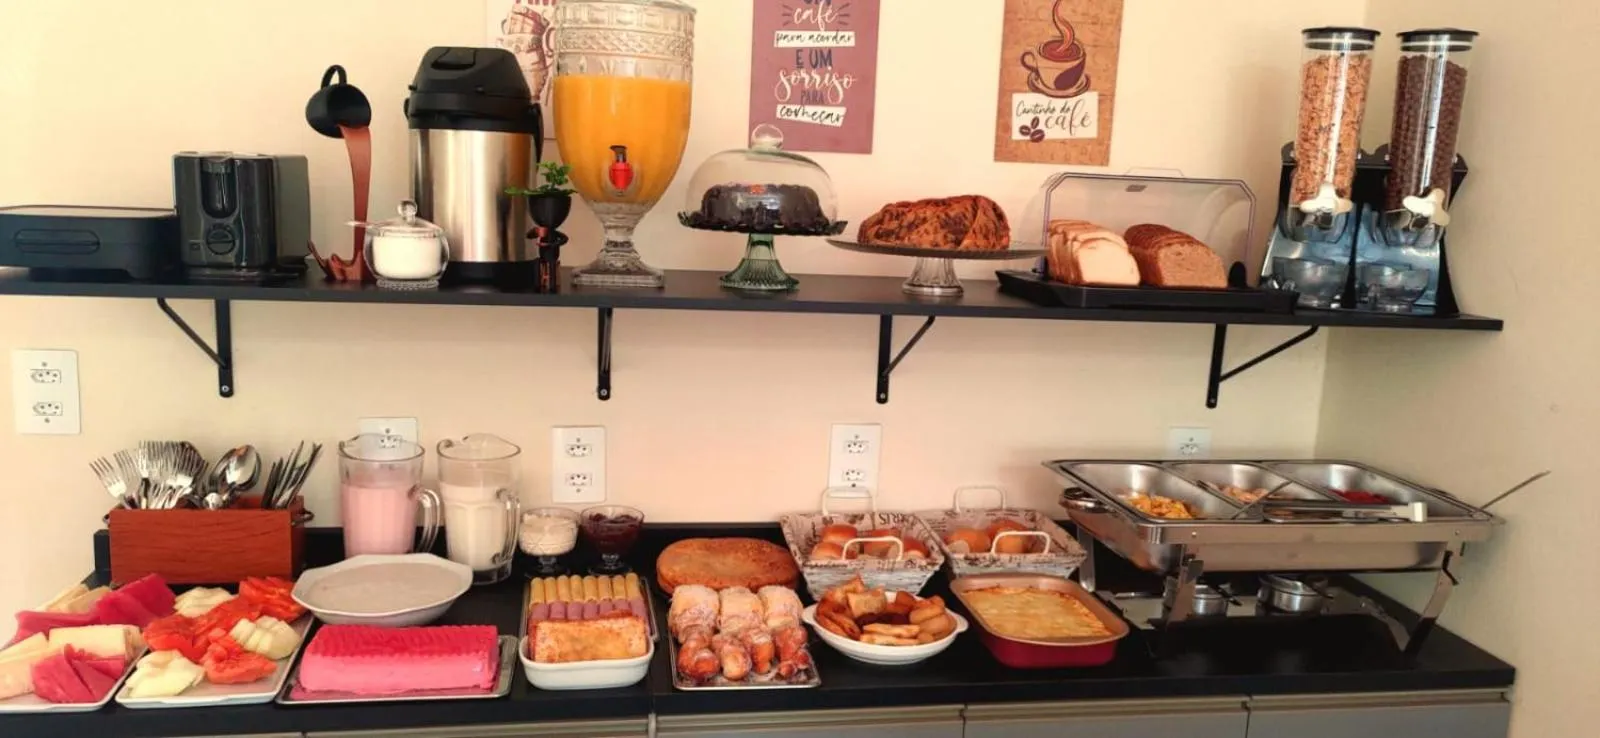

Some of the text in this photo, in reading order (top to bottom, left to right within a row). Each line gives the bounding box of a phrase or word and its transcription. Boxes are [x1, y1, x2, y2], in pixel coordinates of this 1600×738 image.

[794, 0, 839, 31] café
[776, 30, 852, 46] para acordar
[809, 47, 833, 69] UM
[1015, 99, 1056, 118] Cantinho
[1044, 98, 1093, 137] café
